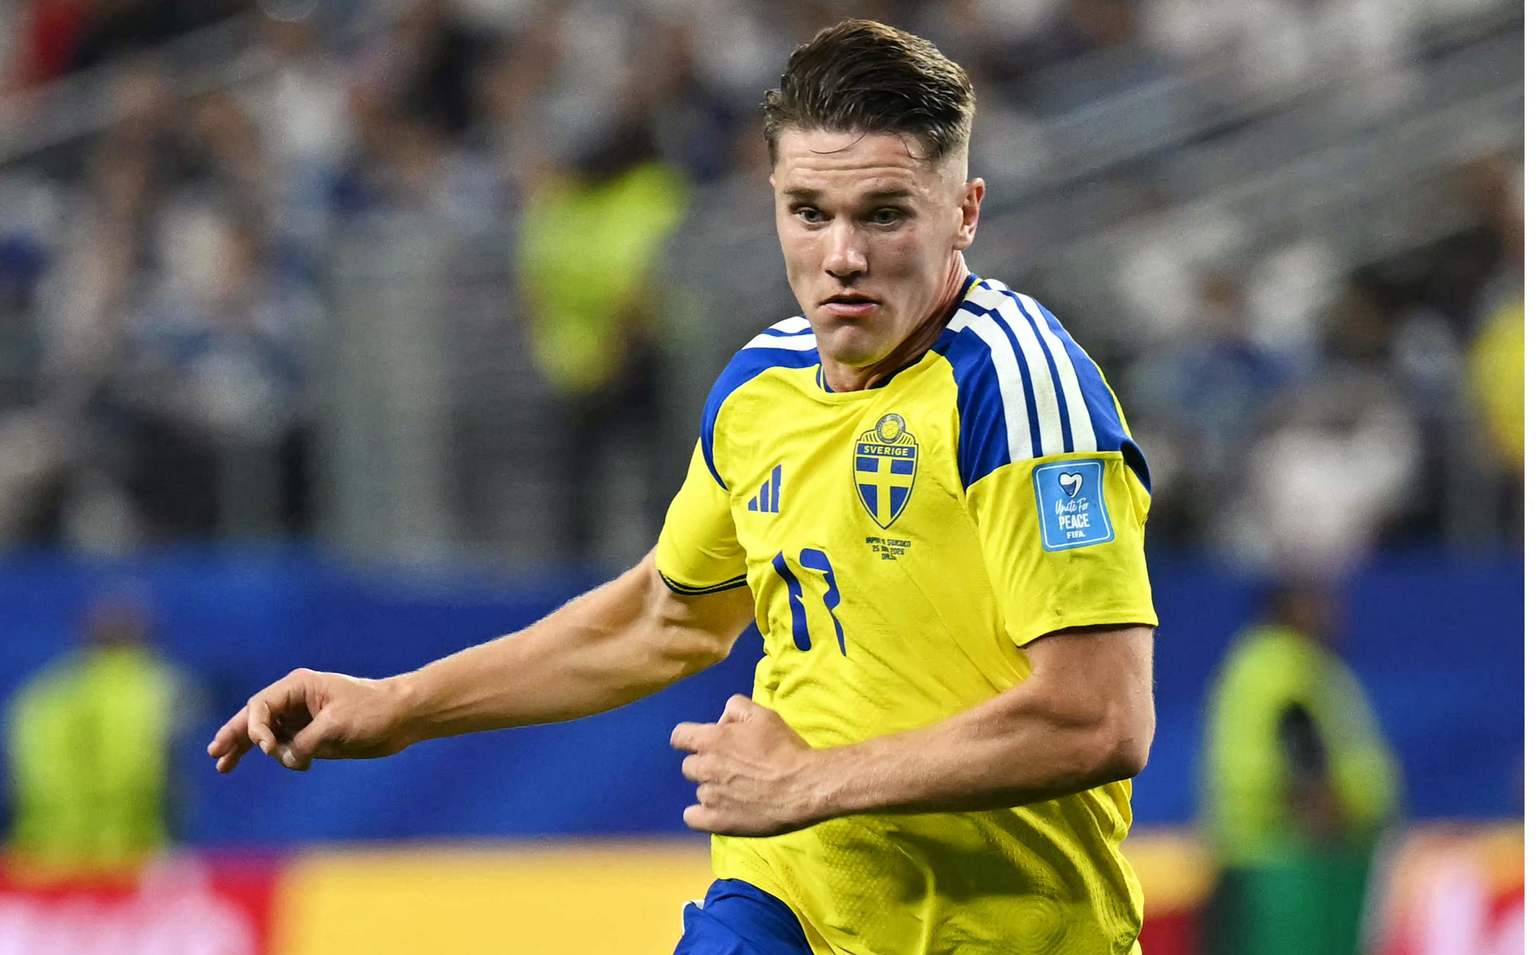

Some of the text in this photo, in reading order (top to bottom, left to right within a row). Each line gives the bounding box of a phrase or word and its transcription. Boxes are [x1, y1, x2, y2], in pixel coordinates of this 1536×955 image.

[863, 444, 909, 457] SVERIGE
[1055, 497, 1090, 515] Unite For
[1058, 513, 1091, 530] PEACE
[771, 549, 847, 657] 17
